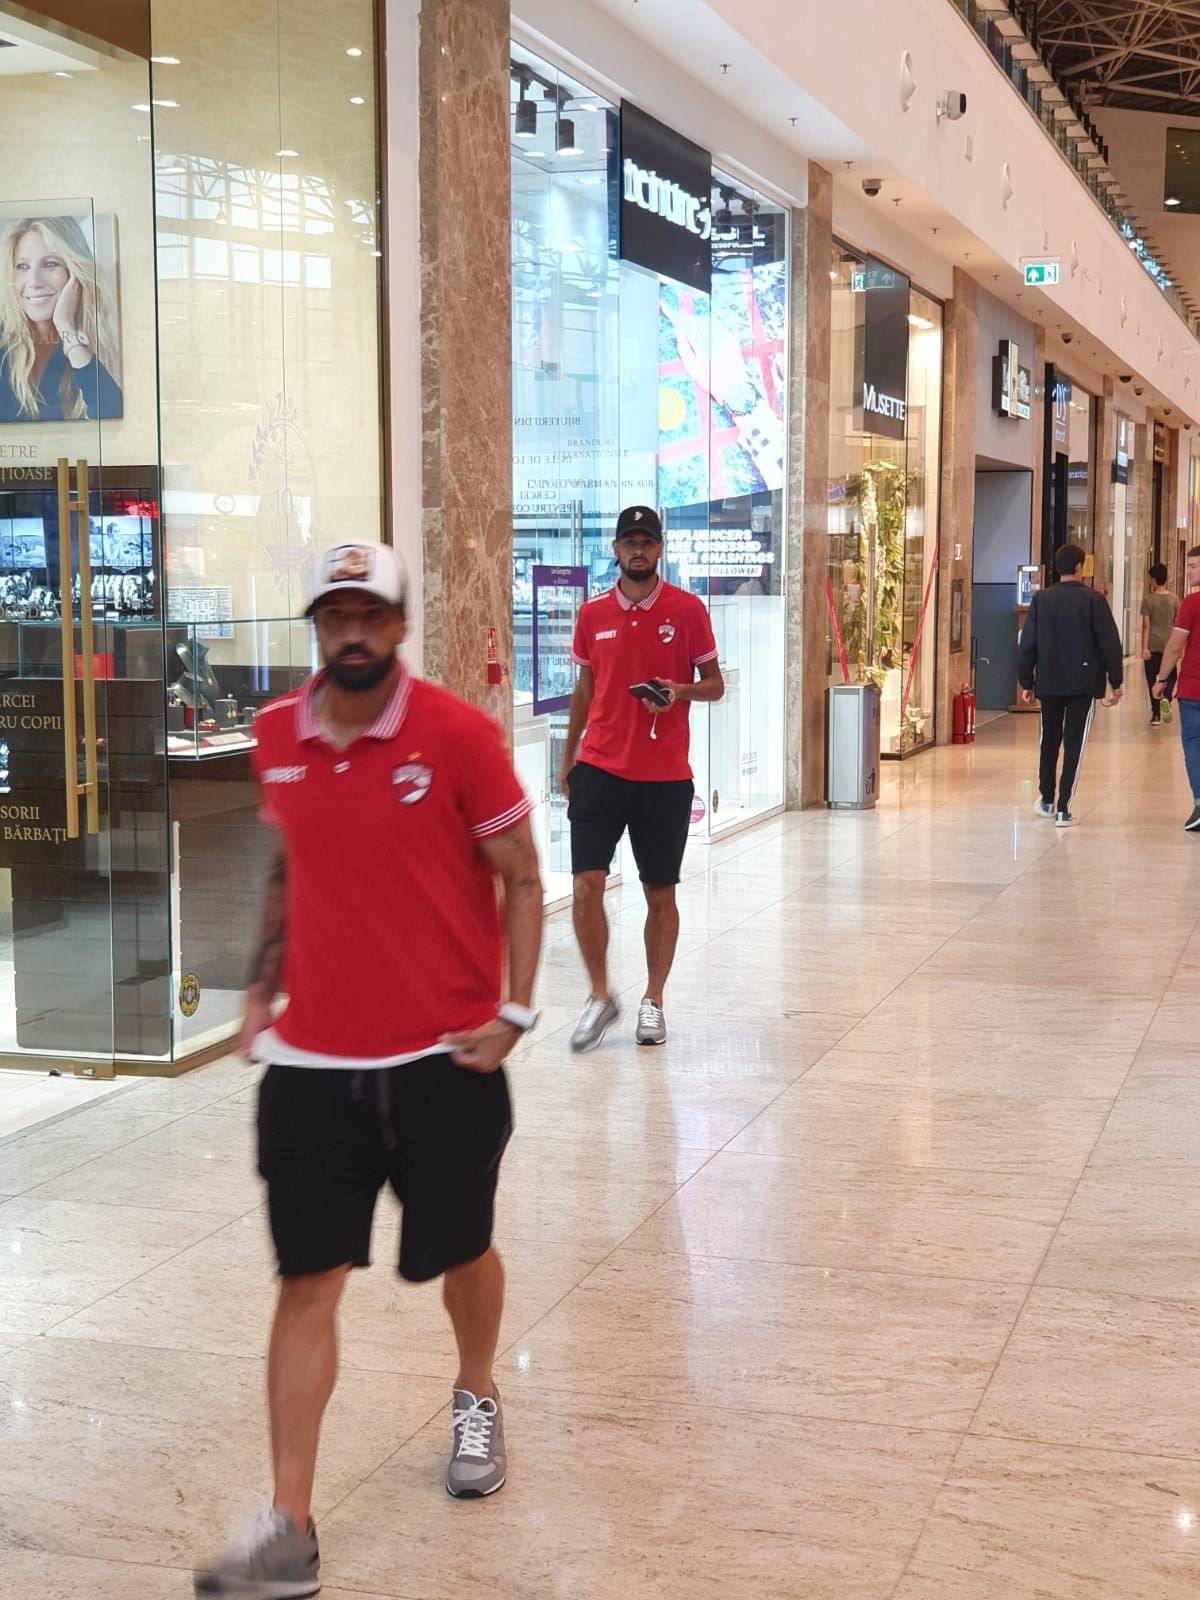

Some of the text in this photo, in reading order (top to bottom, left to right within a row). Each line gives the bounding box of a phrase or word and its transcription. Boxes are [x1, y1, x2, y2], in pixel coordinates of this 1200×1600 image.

[863, 382, 905, 420] MUSETTE
[21, 716, 62, 729] COPII
[0, 806, 40, 820] SORII
